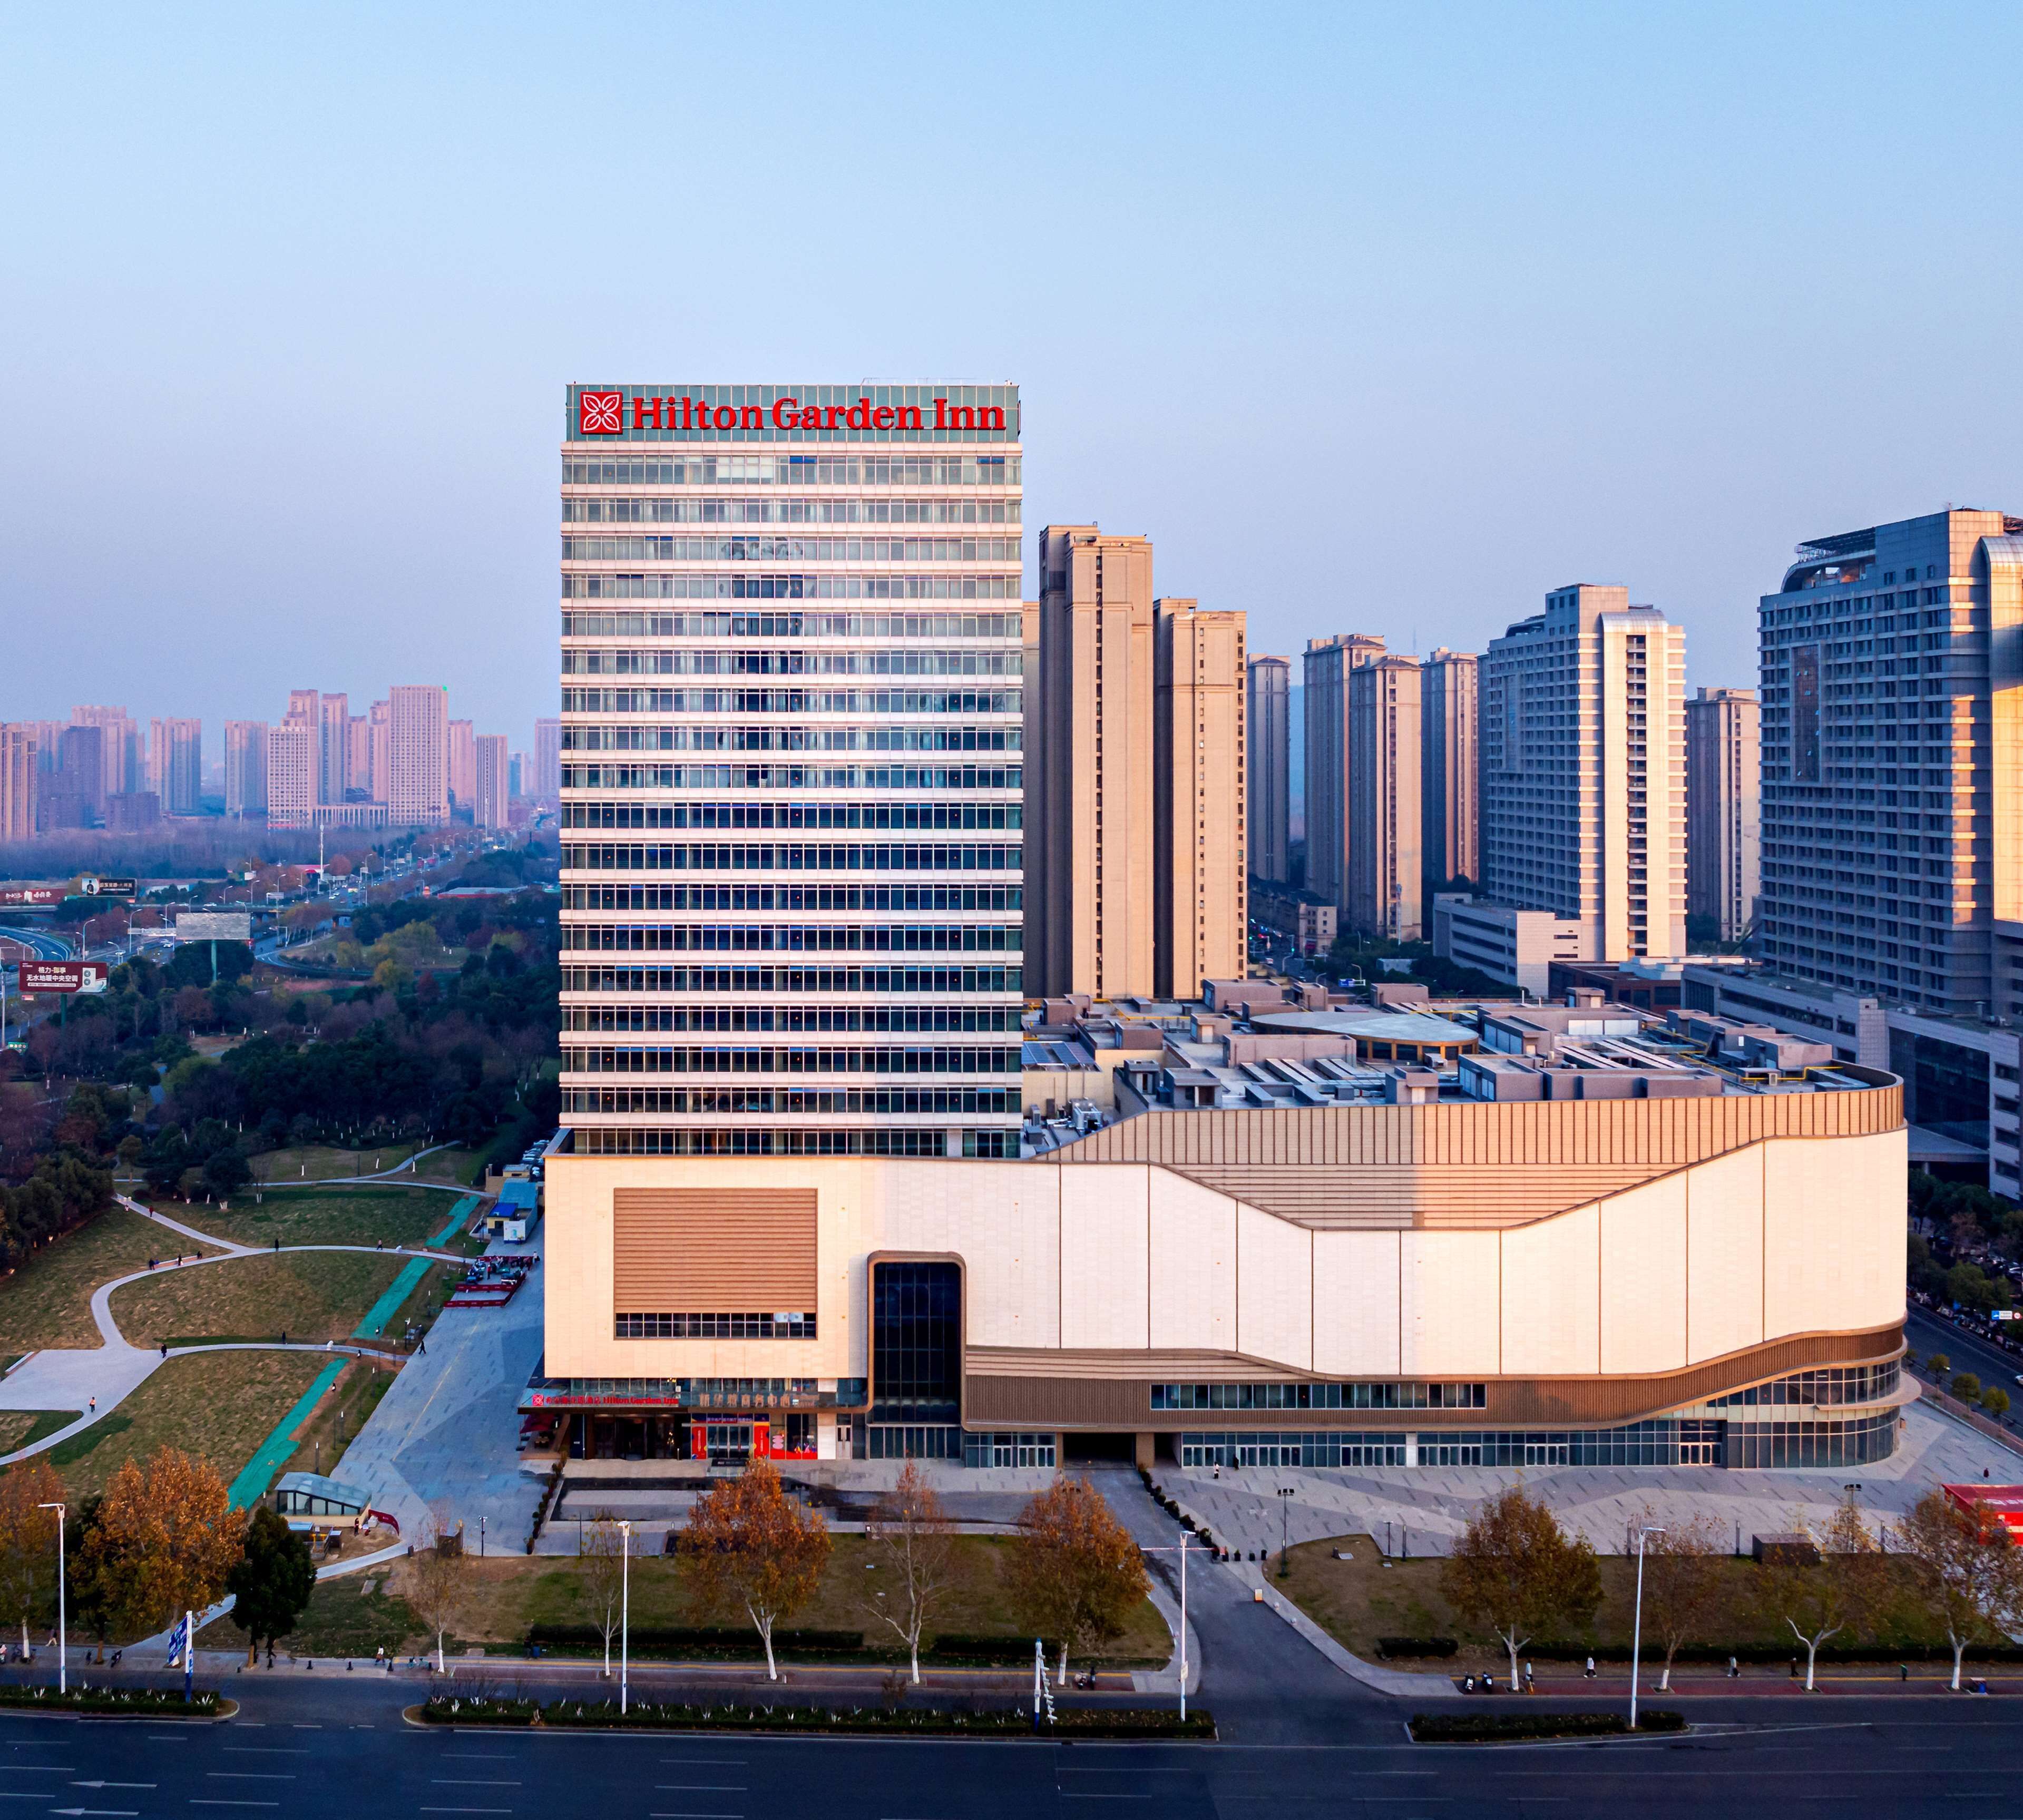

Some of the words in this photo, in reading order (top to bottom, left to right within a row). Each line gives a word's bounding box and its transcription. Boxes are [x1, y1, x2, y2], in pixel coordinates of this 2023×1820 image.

[632, 396, 764, 429] Hilton
[771, 397, 924, 429] Garden
[933, 398, 1007, 429] Inn
[26, 974, 78, 982] 无水地暖中央空调
